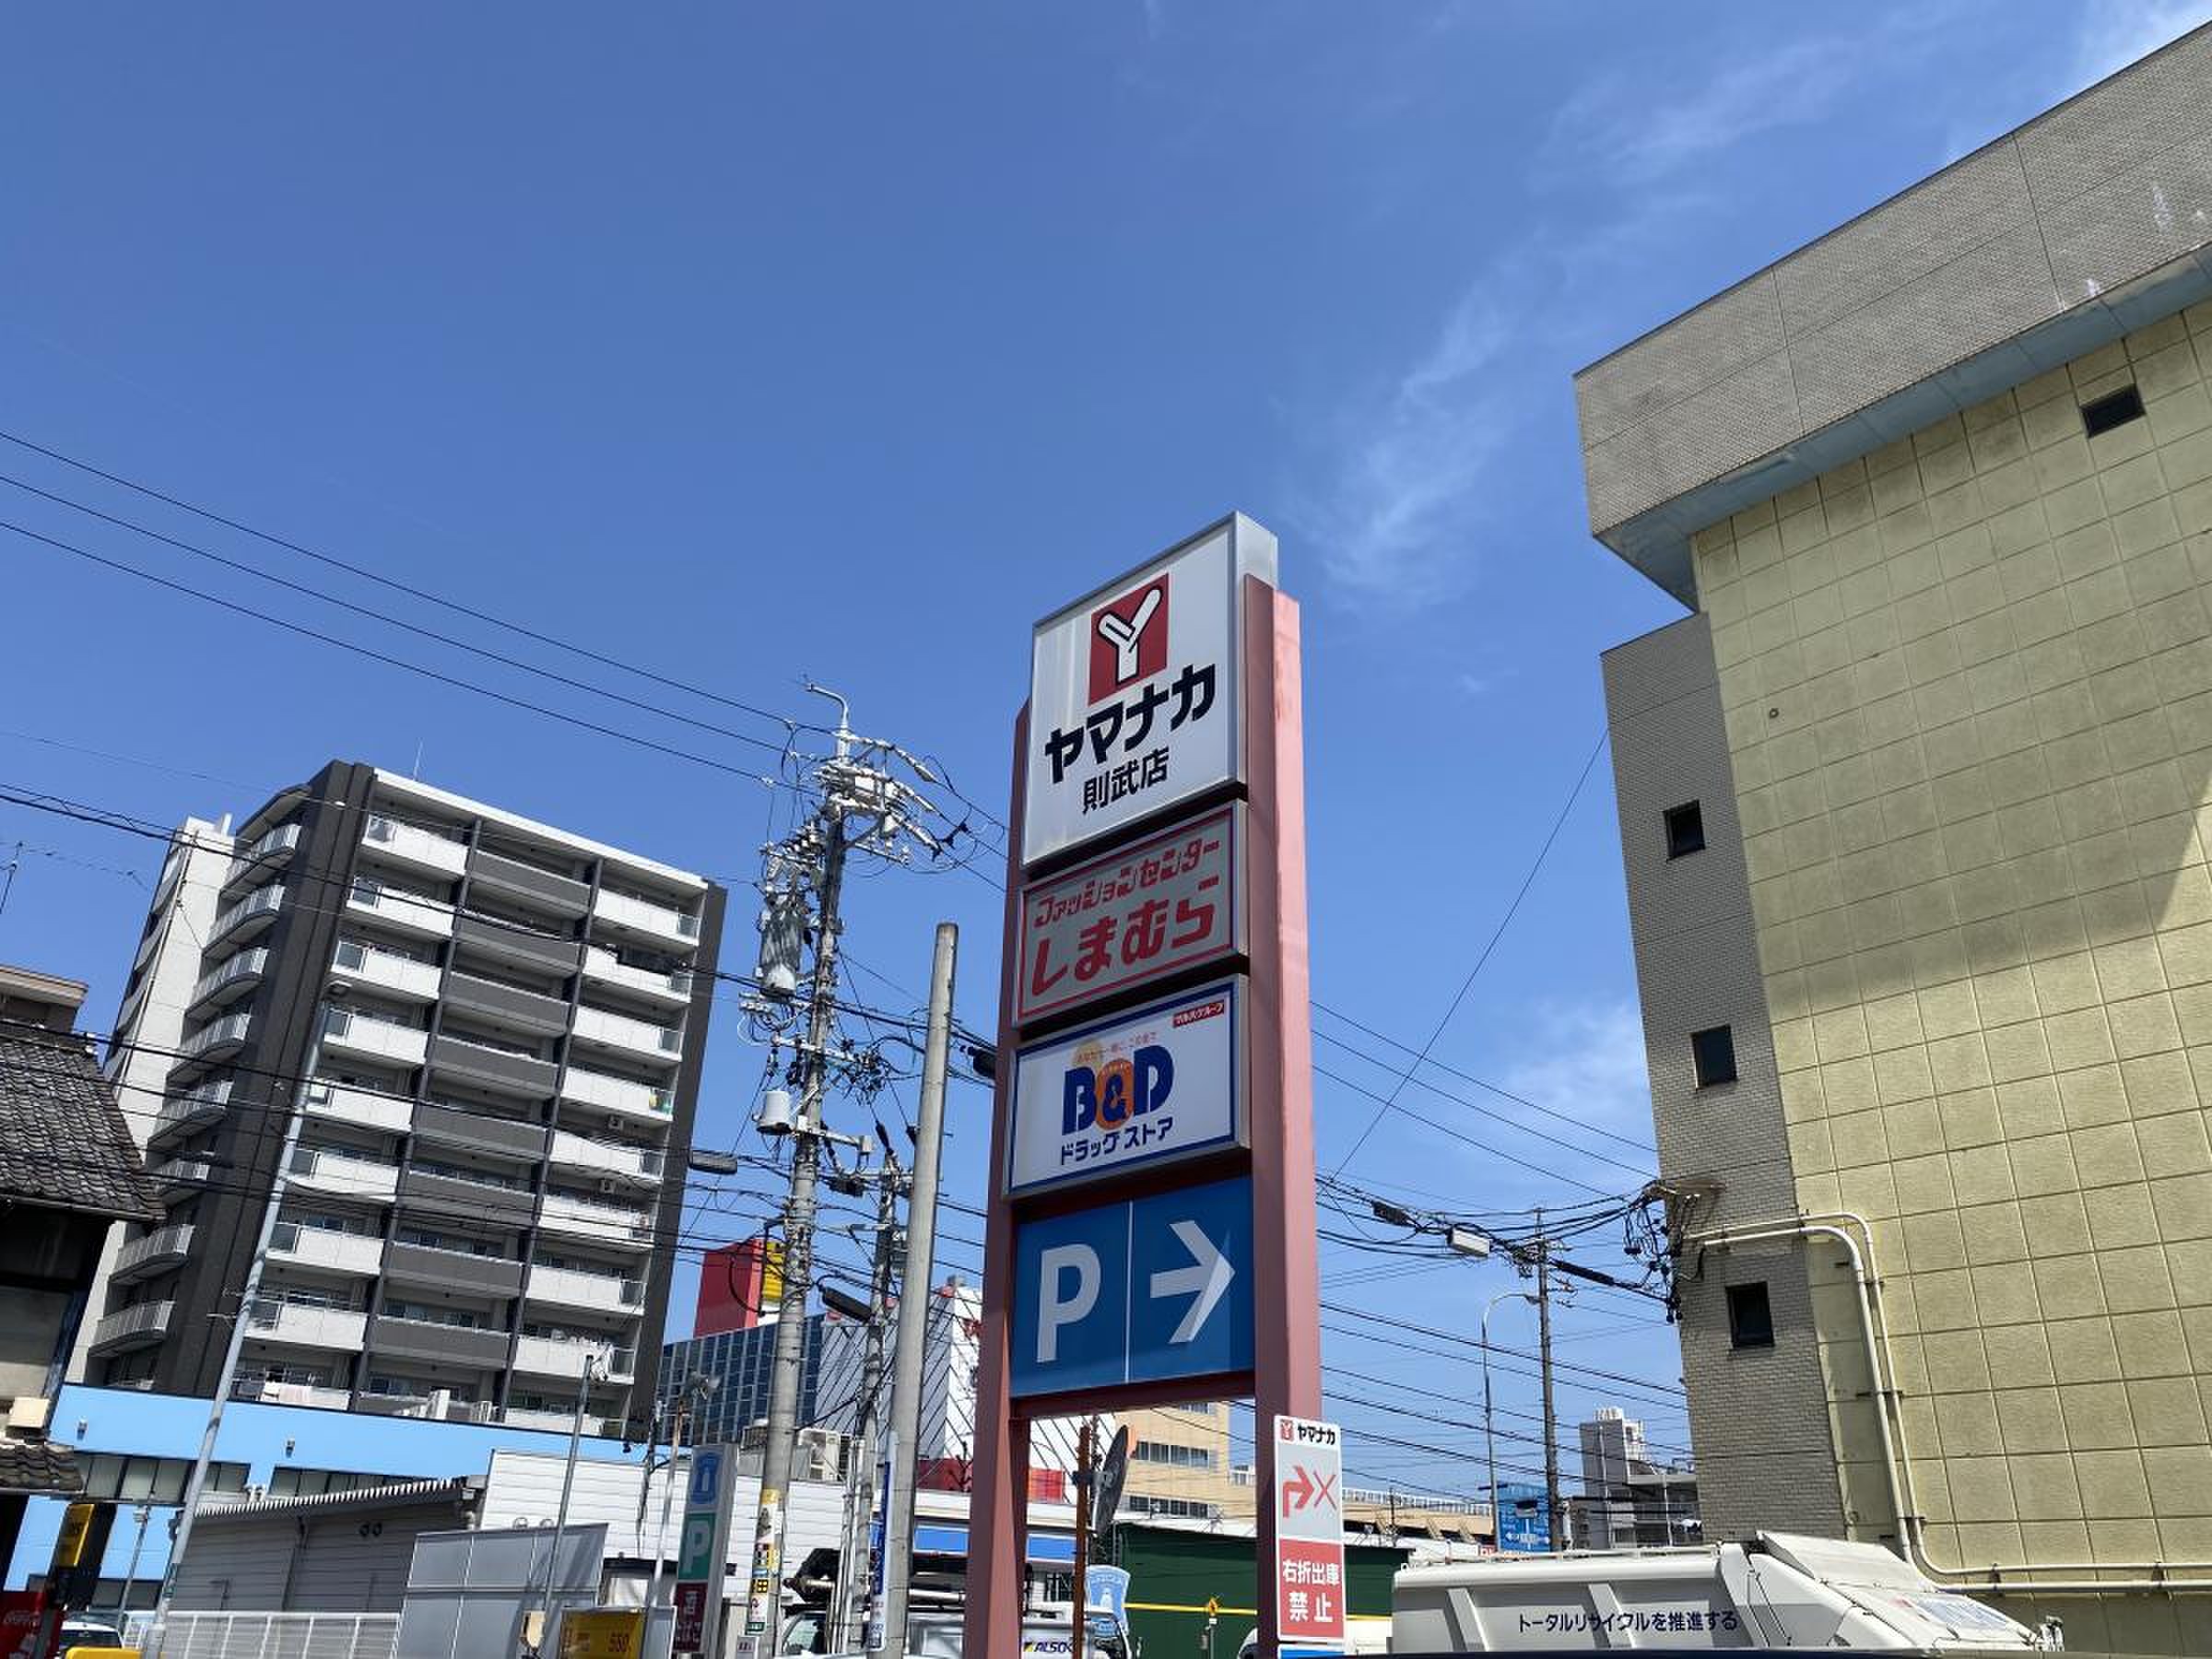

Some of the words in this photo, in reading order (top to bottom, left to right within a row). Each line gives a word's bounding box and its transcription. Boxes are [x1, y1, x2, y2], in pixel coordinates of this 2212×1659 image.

[1044, 663, 1216, 784] ヤマナカ
[1082, 747, 1170, 815] 則武店
[1033, 839, 1219, 928] ファッションセンター
[1031, 876, 1219, 995] しまむら
[1062, 1044, 1174, 1136] B&D
[1062, 1116, 1173, 1166] ドラッグストア
[1036, 1243, 1102, 1364] P
[1298, 1425, 1335, 1446] ヤマナカ
[682, 1521, 710, 1574] P
[1282, 1559, 1341, 1586] 右折出庫
[1288, 1591, 1334, 1623] 禁止
[1519, 1610, 1738, 1633] トータルリサイクルを推進する
